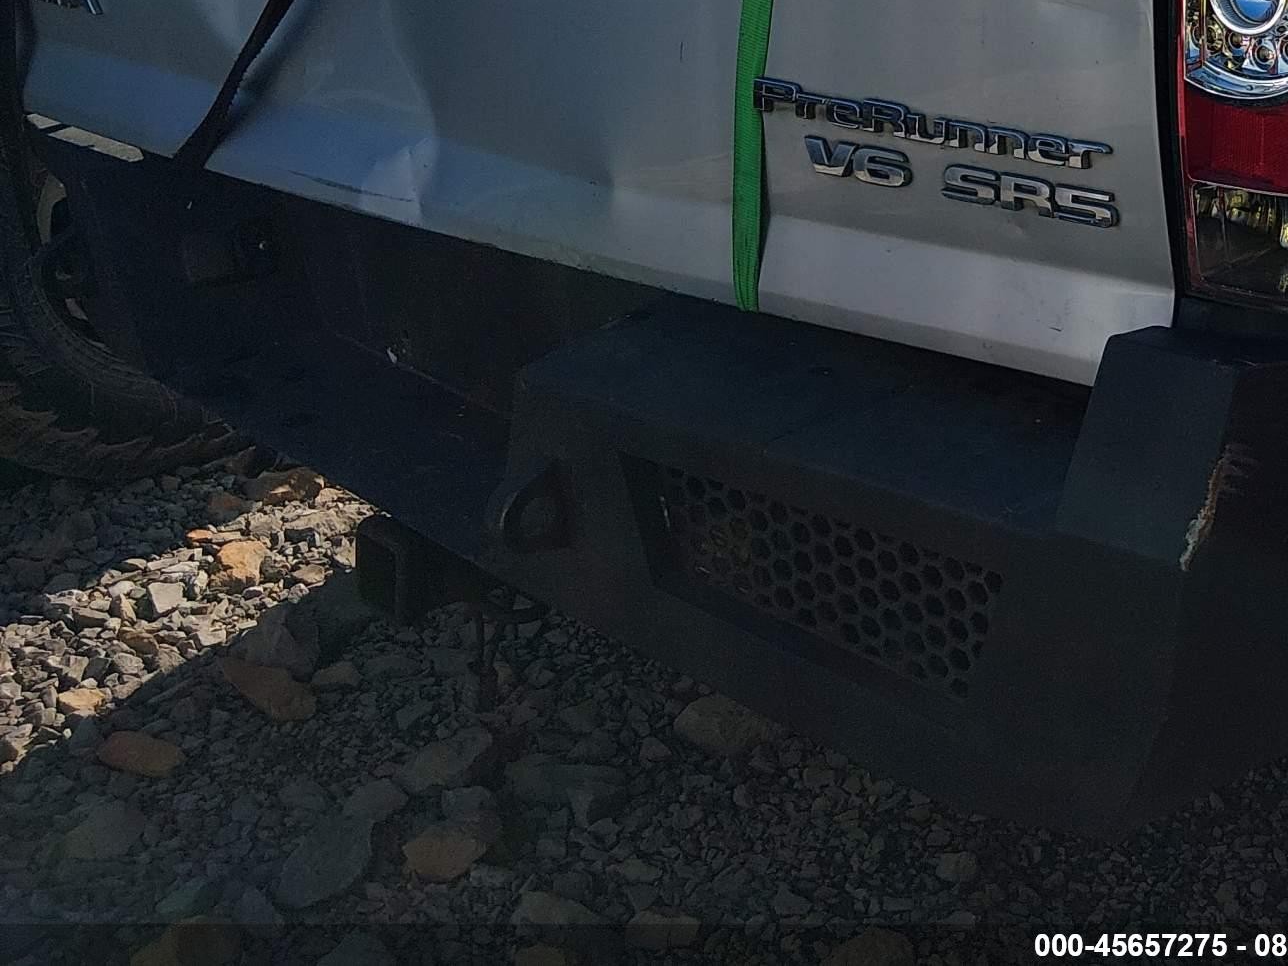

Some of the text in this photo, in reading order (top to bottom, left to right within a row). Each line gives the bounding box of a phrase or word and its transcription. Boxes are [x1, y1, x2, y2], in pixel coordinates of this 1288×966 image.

[754, 75, 1114, 170] PreRunner
[804, 134, 1120, 229] V6 SR5
